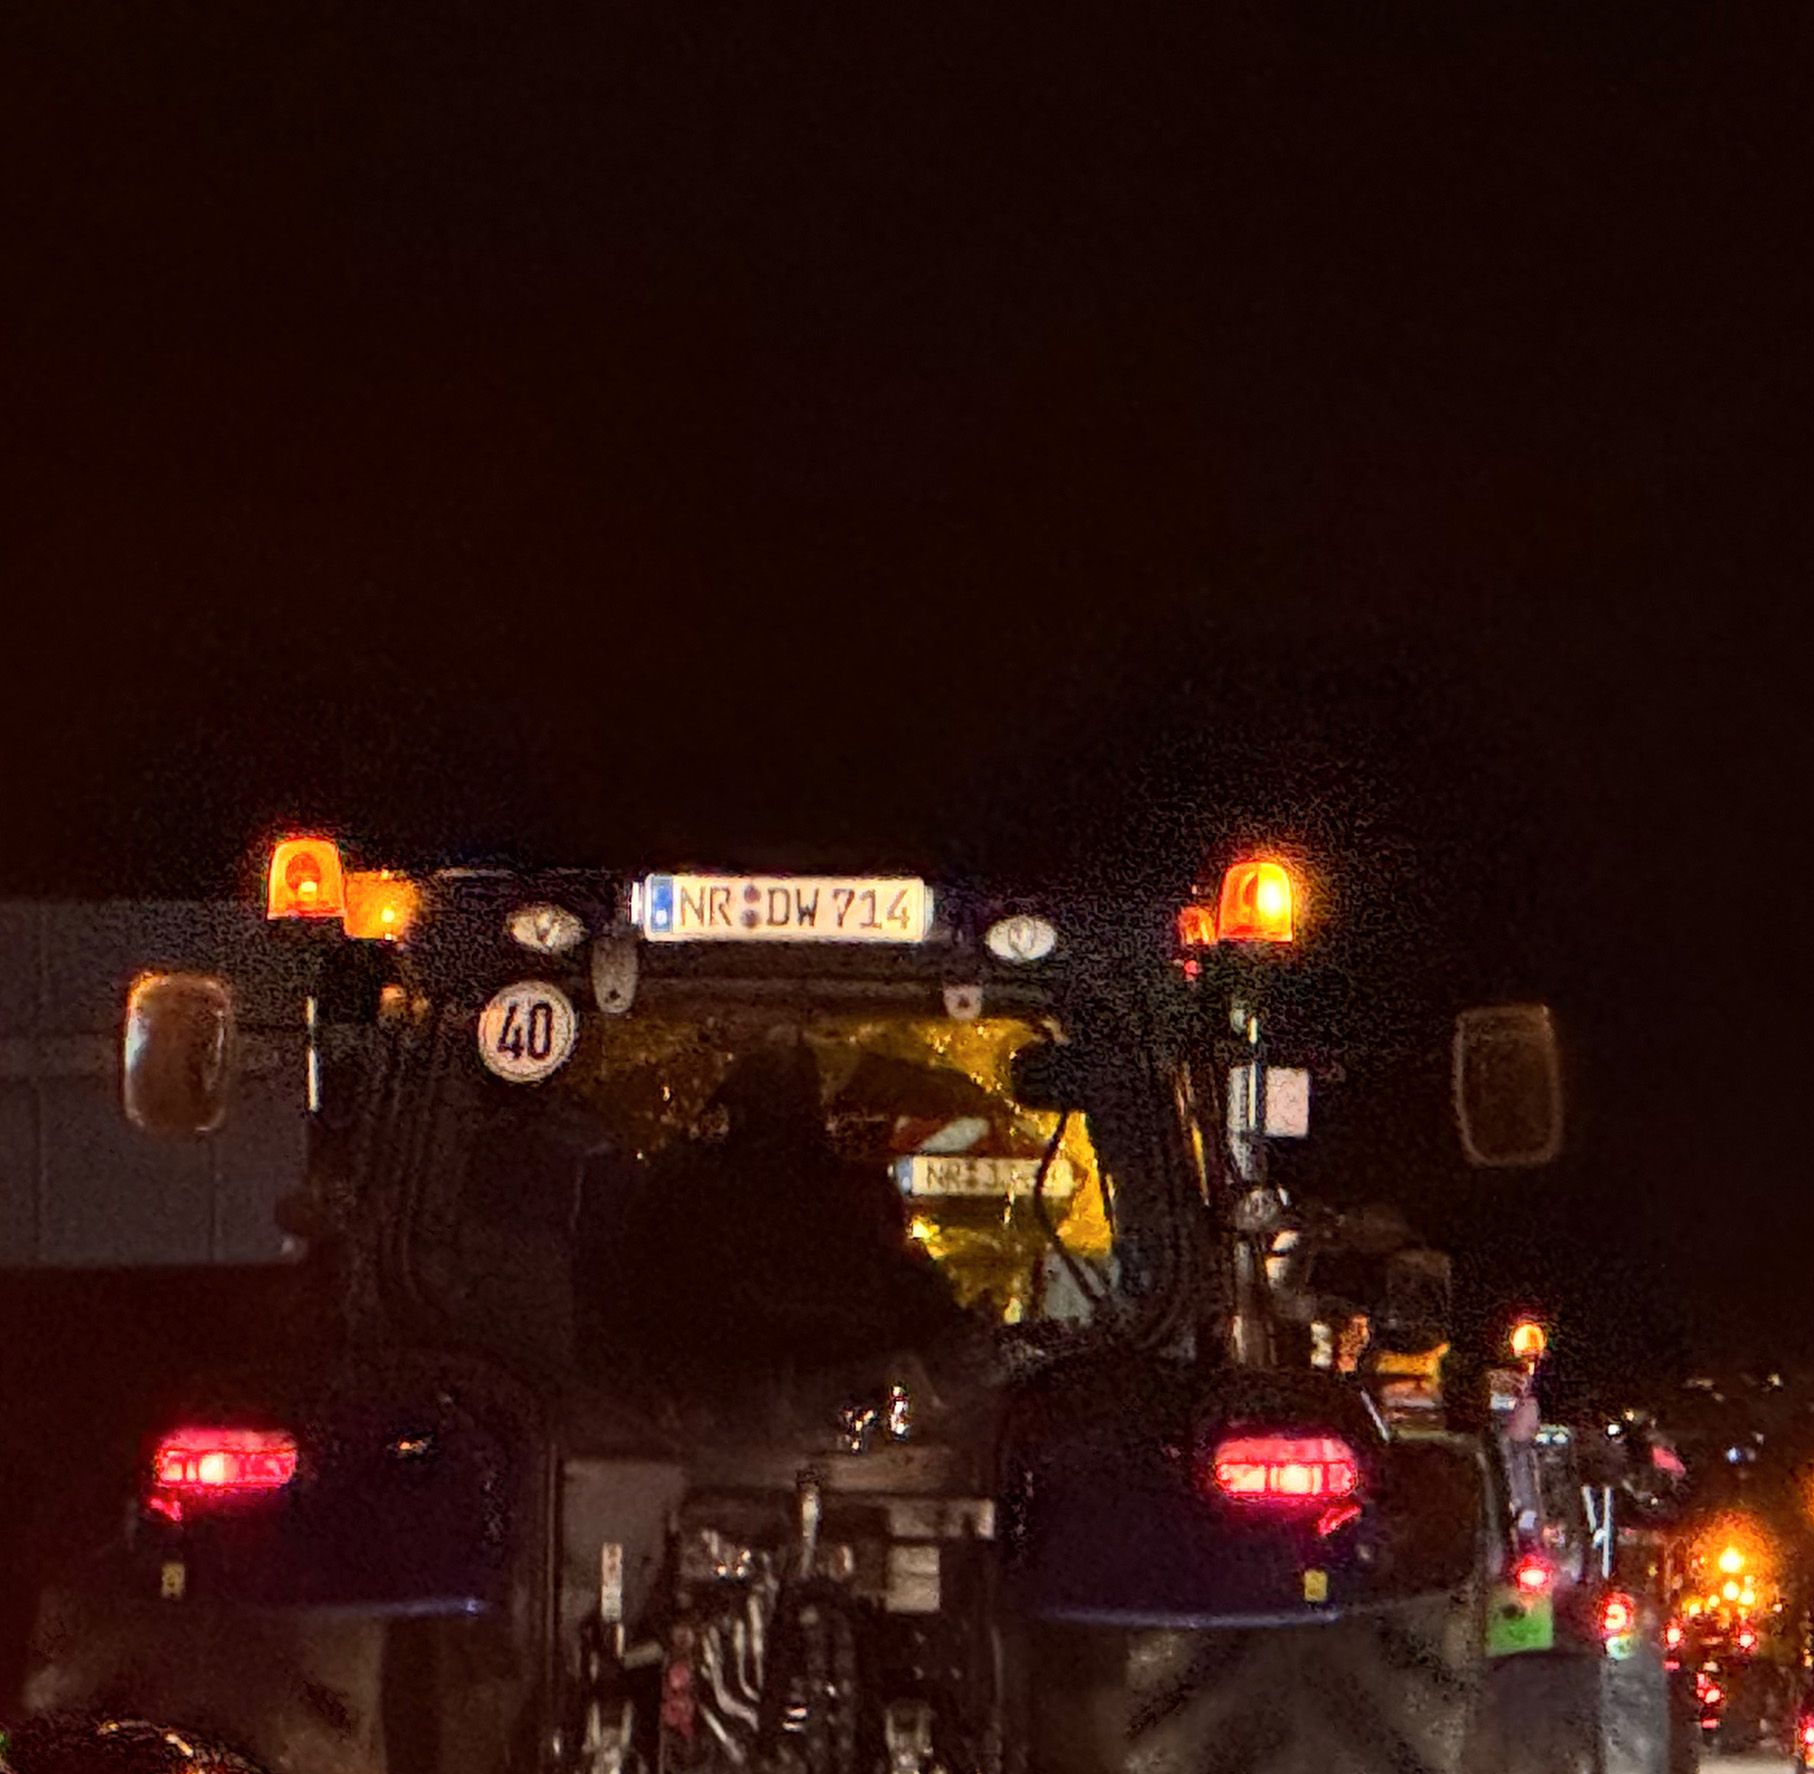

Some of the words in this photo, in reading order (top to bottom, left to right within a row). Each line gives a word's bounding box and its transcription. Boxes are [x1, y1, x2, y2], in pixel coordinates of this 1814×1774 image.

[680, 886, 732, 927] NR
[766, 887, 819, 927] DW
[832, 888, 911, 929] 714
[496, 1003, 553, 1060] 40
